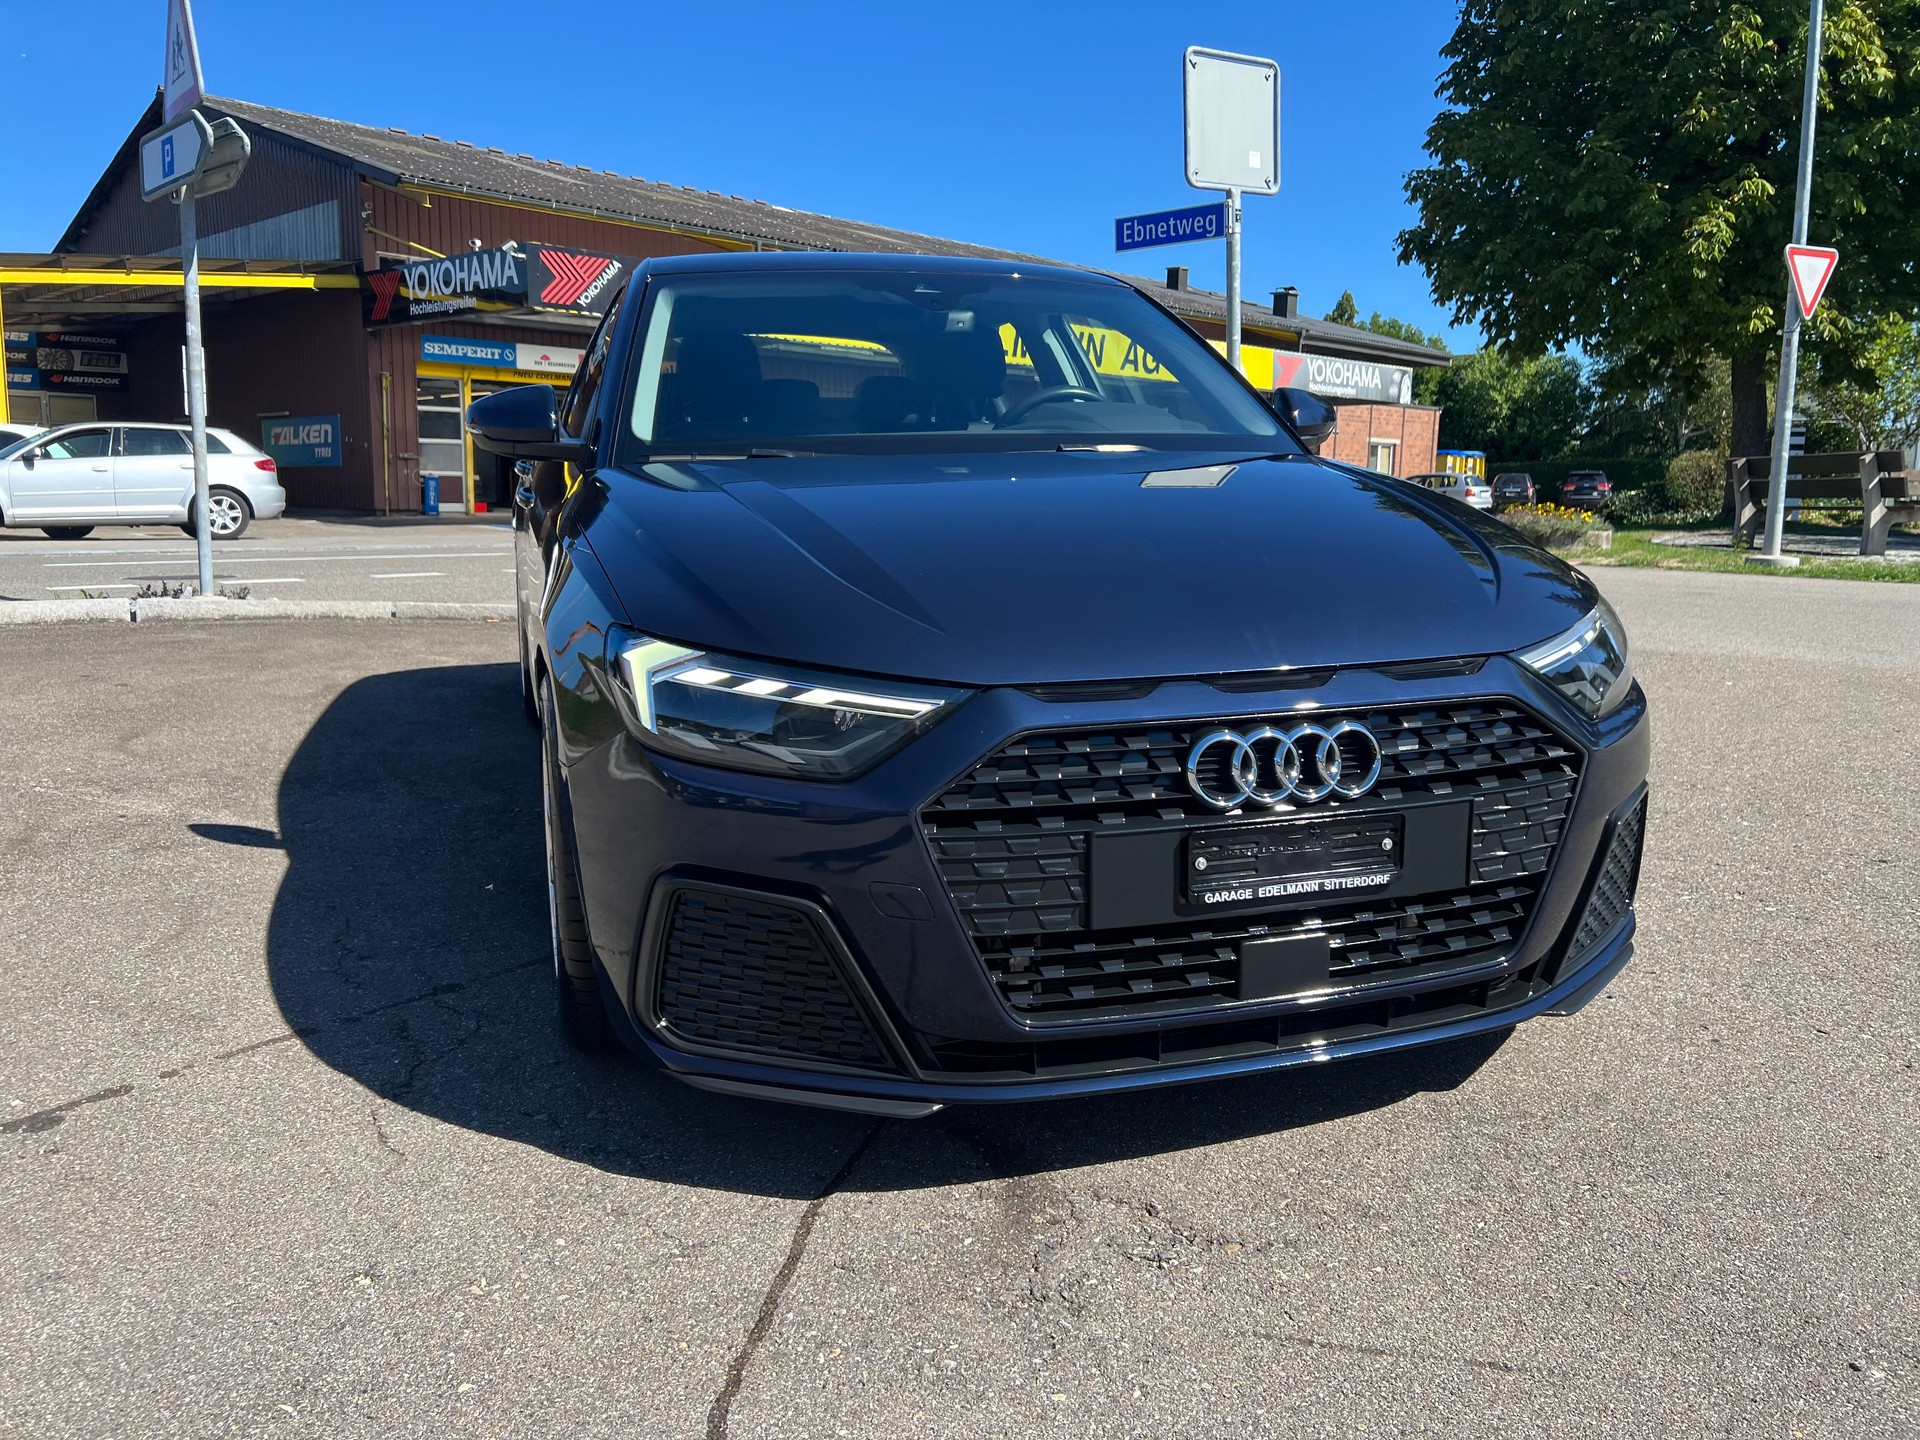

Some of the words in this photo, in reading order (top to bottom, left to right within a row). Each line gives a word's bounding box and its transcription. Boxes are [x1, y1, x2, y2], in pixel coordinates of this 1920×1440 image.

[164, 143, 172, 173] P
[1123, 214, 1217, 244] Ebnetweg
[403, 251, 519, 300] YOKOHAMA
[576, 259, 622, 308] YOKOHAMA
[409, 296, 477, 316] Hochleistungsreifen
[4, 332, 29, 342] RES
[424, 342, 501, 360] SEMPERIT
[8, 374, 32, 383] RES
[513, 371, 534, 379] PNEU
[1307, 358, 1382, 390] YOKOHAMA
[271, 424, 332, 446] FALKEN
[1204, 889, 1253, 904] GARAGE
[1258, 881, 1319, 898] EDELMANN
[1324, 874, 1391, 891] SITTERDORF
